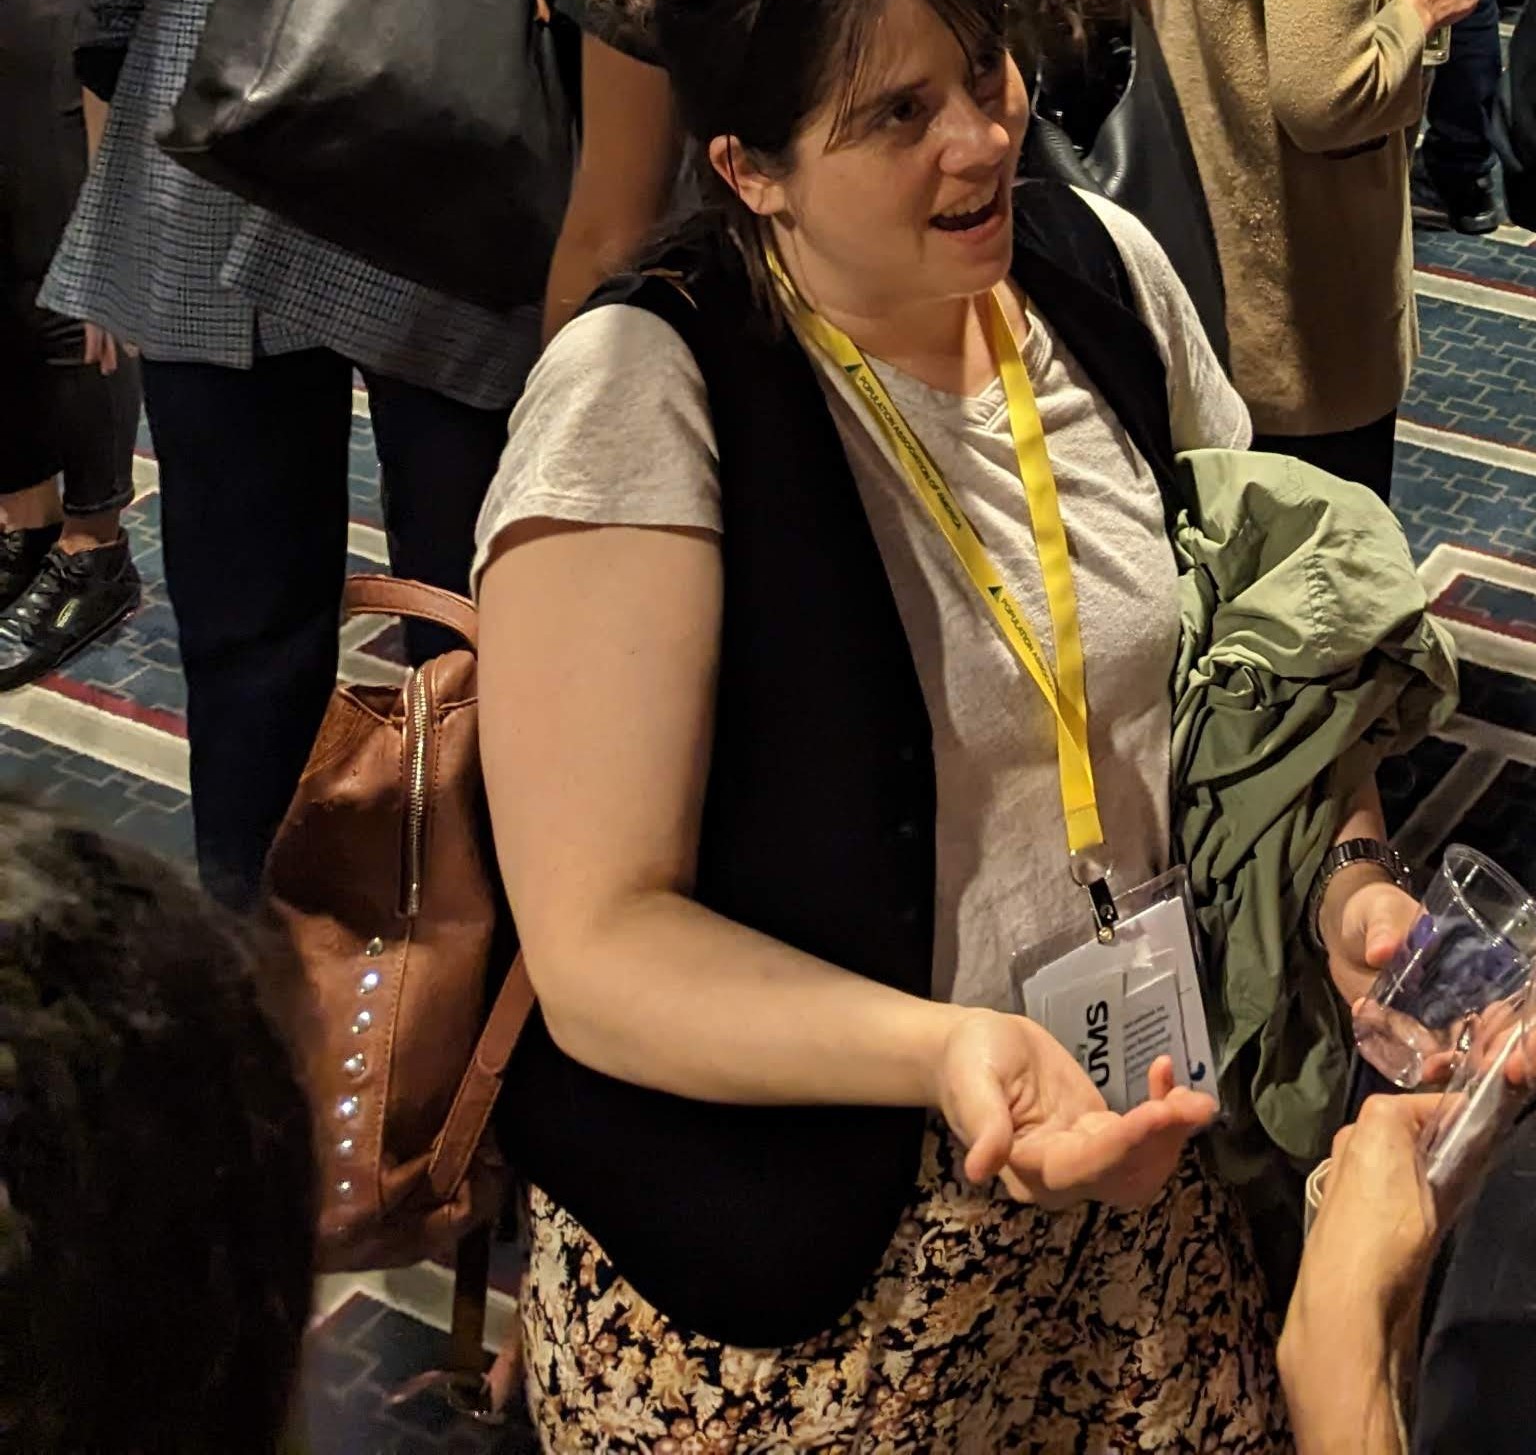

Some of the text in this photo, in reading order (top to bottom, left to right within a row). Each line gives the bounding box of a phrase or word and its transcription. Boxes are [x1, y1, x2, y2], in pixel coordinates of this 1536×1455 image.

[859, 376, 962, 530] POPULATION ASSOCIATION OF AMERICA
[1001, 598, 1033, 652] POPULATION
